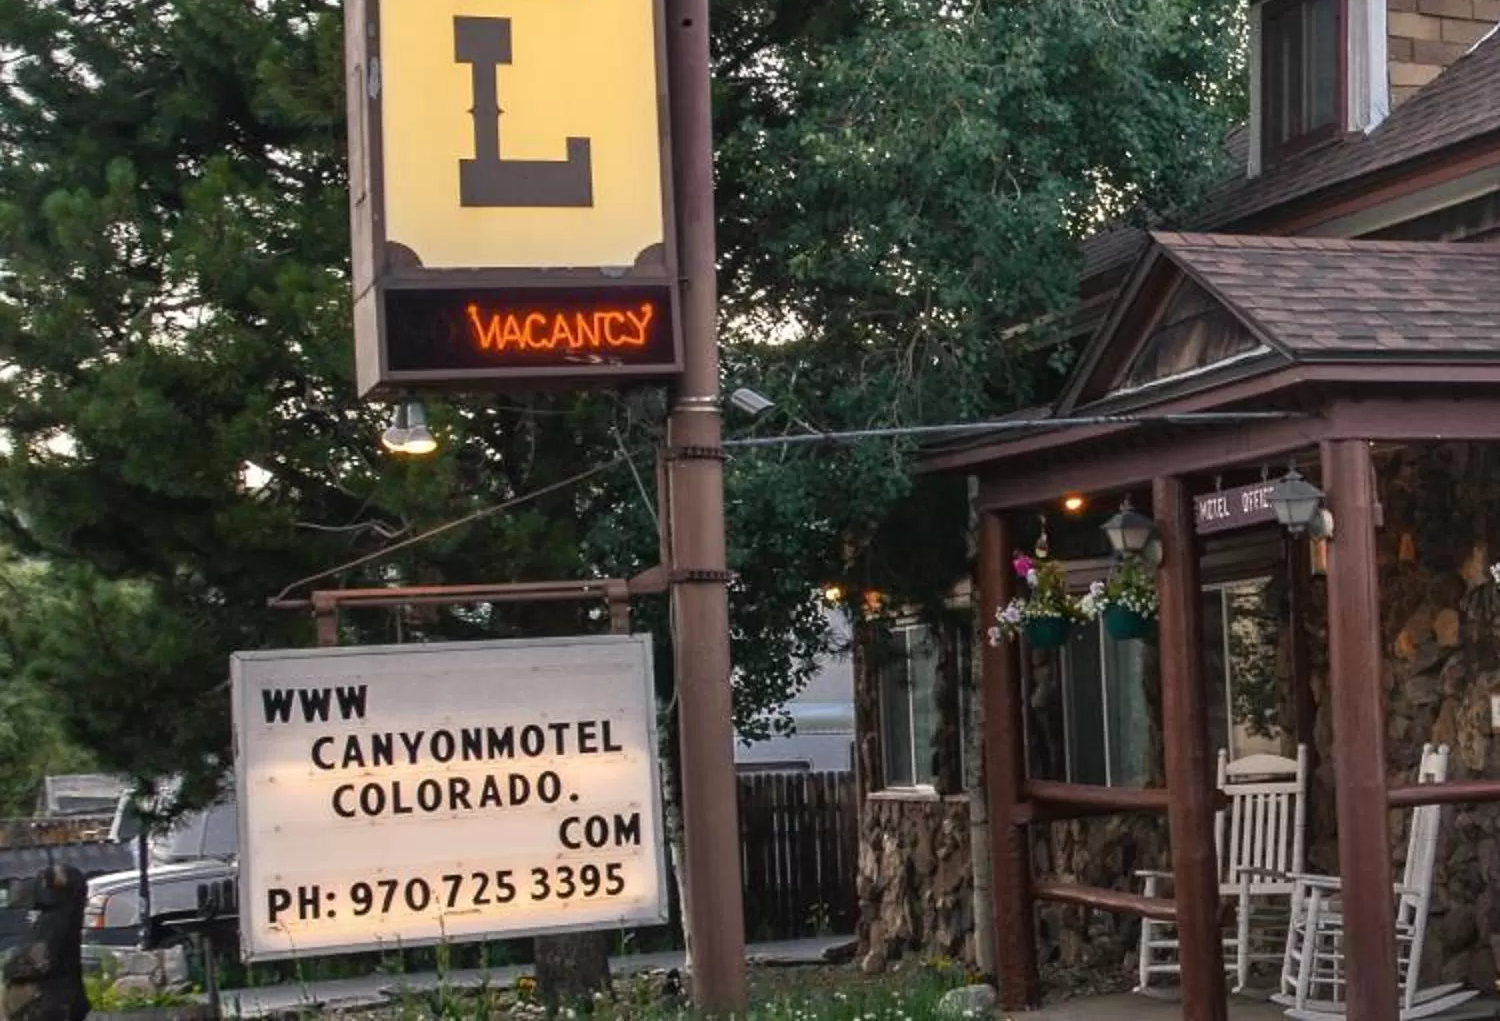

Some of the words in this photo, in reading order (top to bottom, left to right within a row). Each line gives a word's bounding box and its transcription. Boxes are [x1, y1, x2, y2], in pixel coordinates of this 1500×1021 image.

[467, 301, 652, 350] VACANCY
[1200, 496, 1230, 520] MOTEL
[261, 684, 368, 724] WWW
[311, 720, 622, 770] CANYONMOTEL
[332, 770, 580, 818] COLORADO.
[559, 813, 641, 850] COM
[267, 885, 336, 924] PH:
[350, 878, 431, 916] 970
[442, 870, 517, 909] 725
[531, 863, 626, 901] 3395
